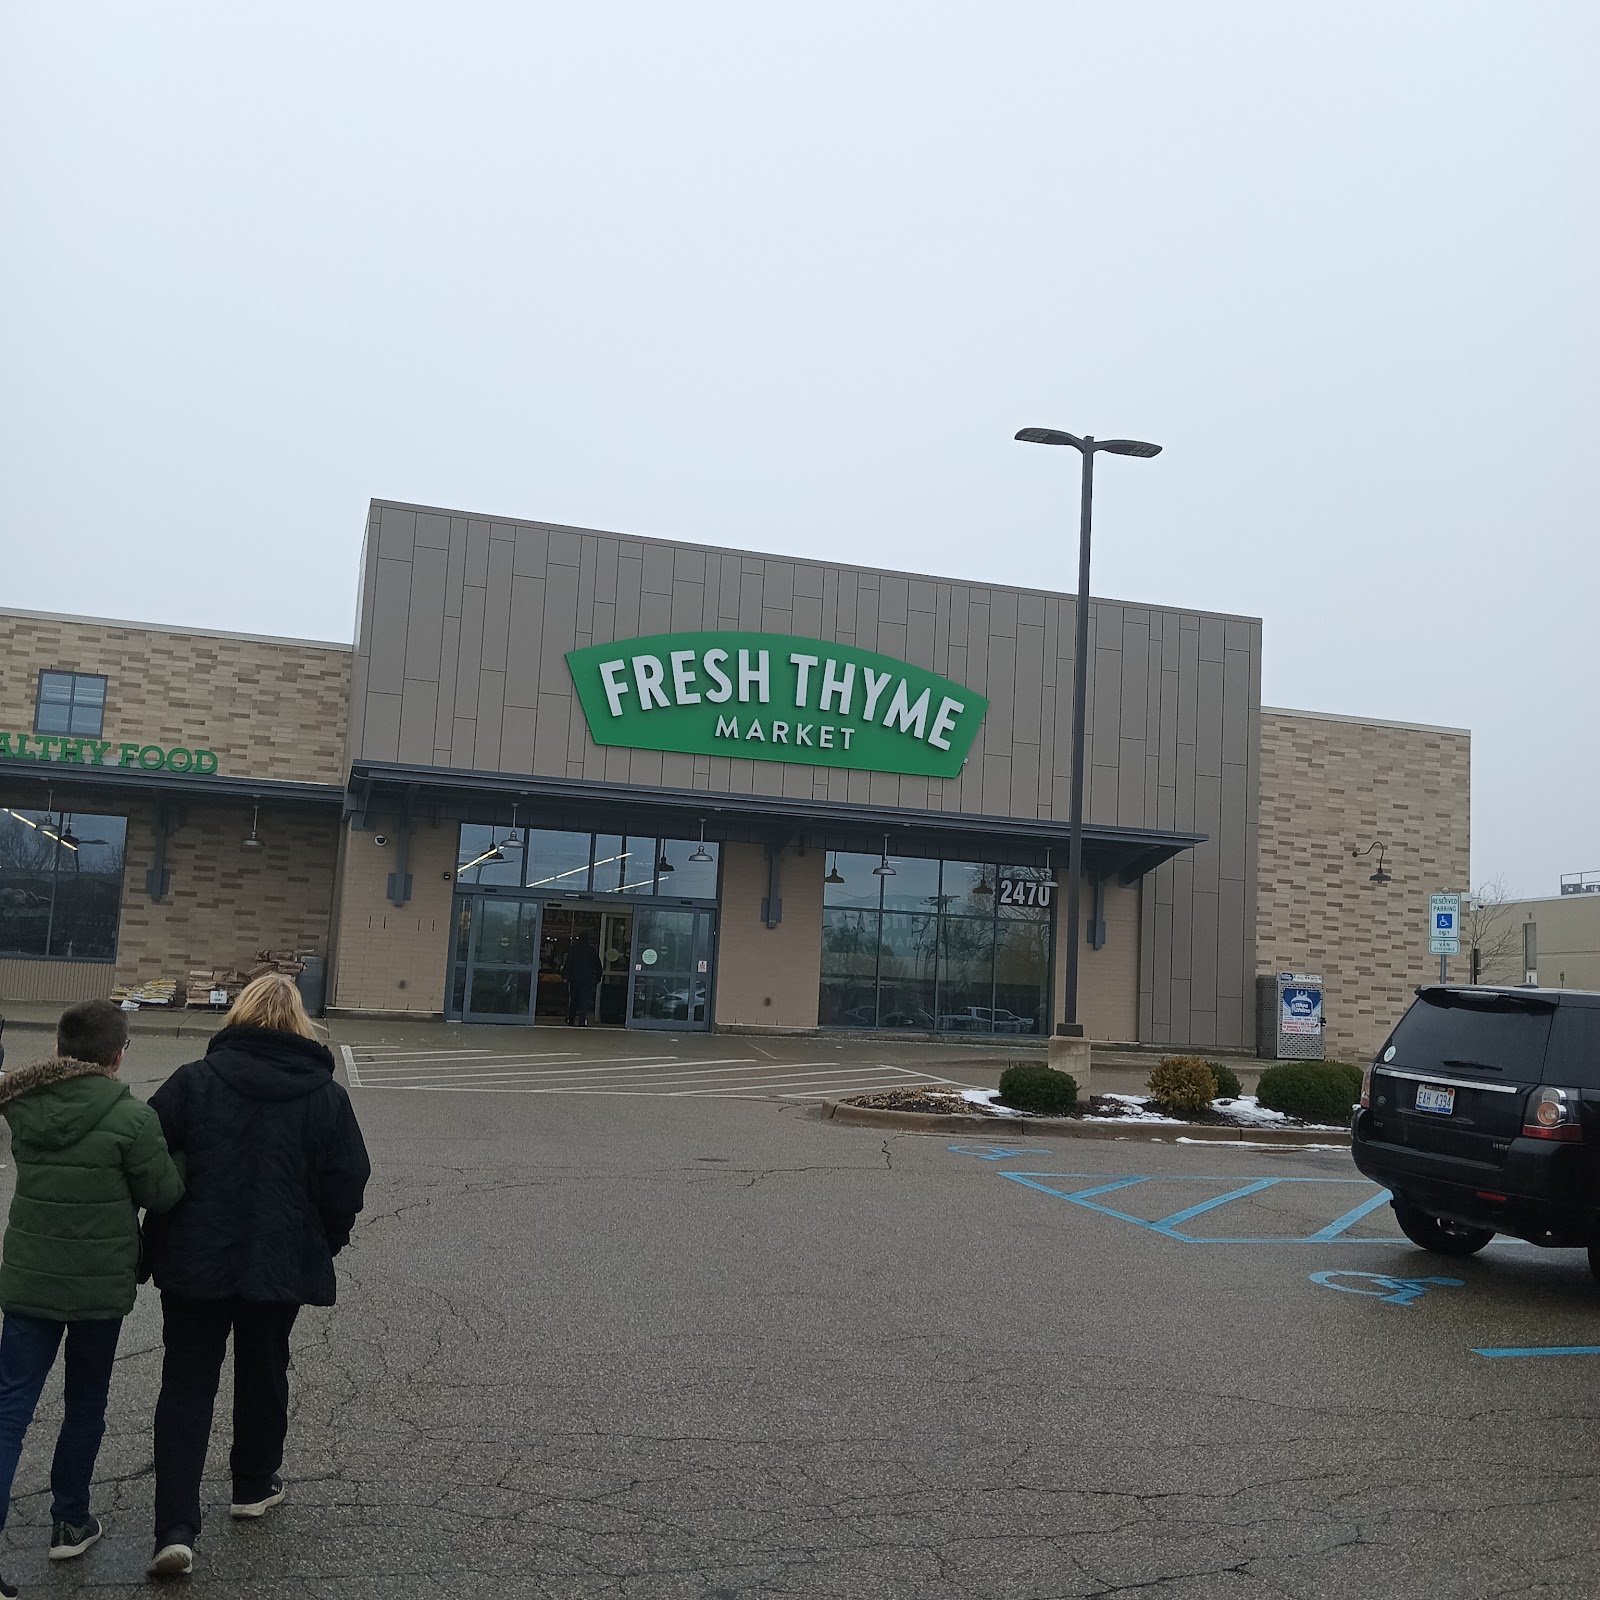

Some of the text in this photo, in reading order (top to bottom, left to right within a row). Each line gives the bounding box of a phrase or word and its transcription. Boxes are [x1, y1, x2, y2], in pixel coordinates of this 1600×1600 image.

[598, 648, 965, 752] FRESH THYME
[715, 715, 856, 750] MARKET
[118, 743, 218, 774] FOOD
[1000, 879, 1050, 907] 2470
[1417, 1091, 1452, 1108] EAH 4394
